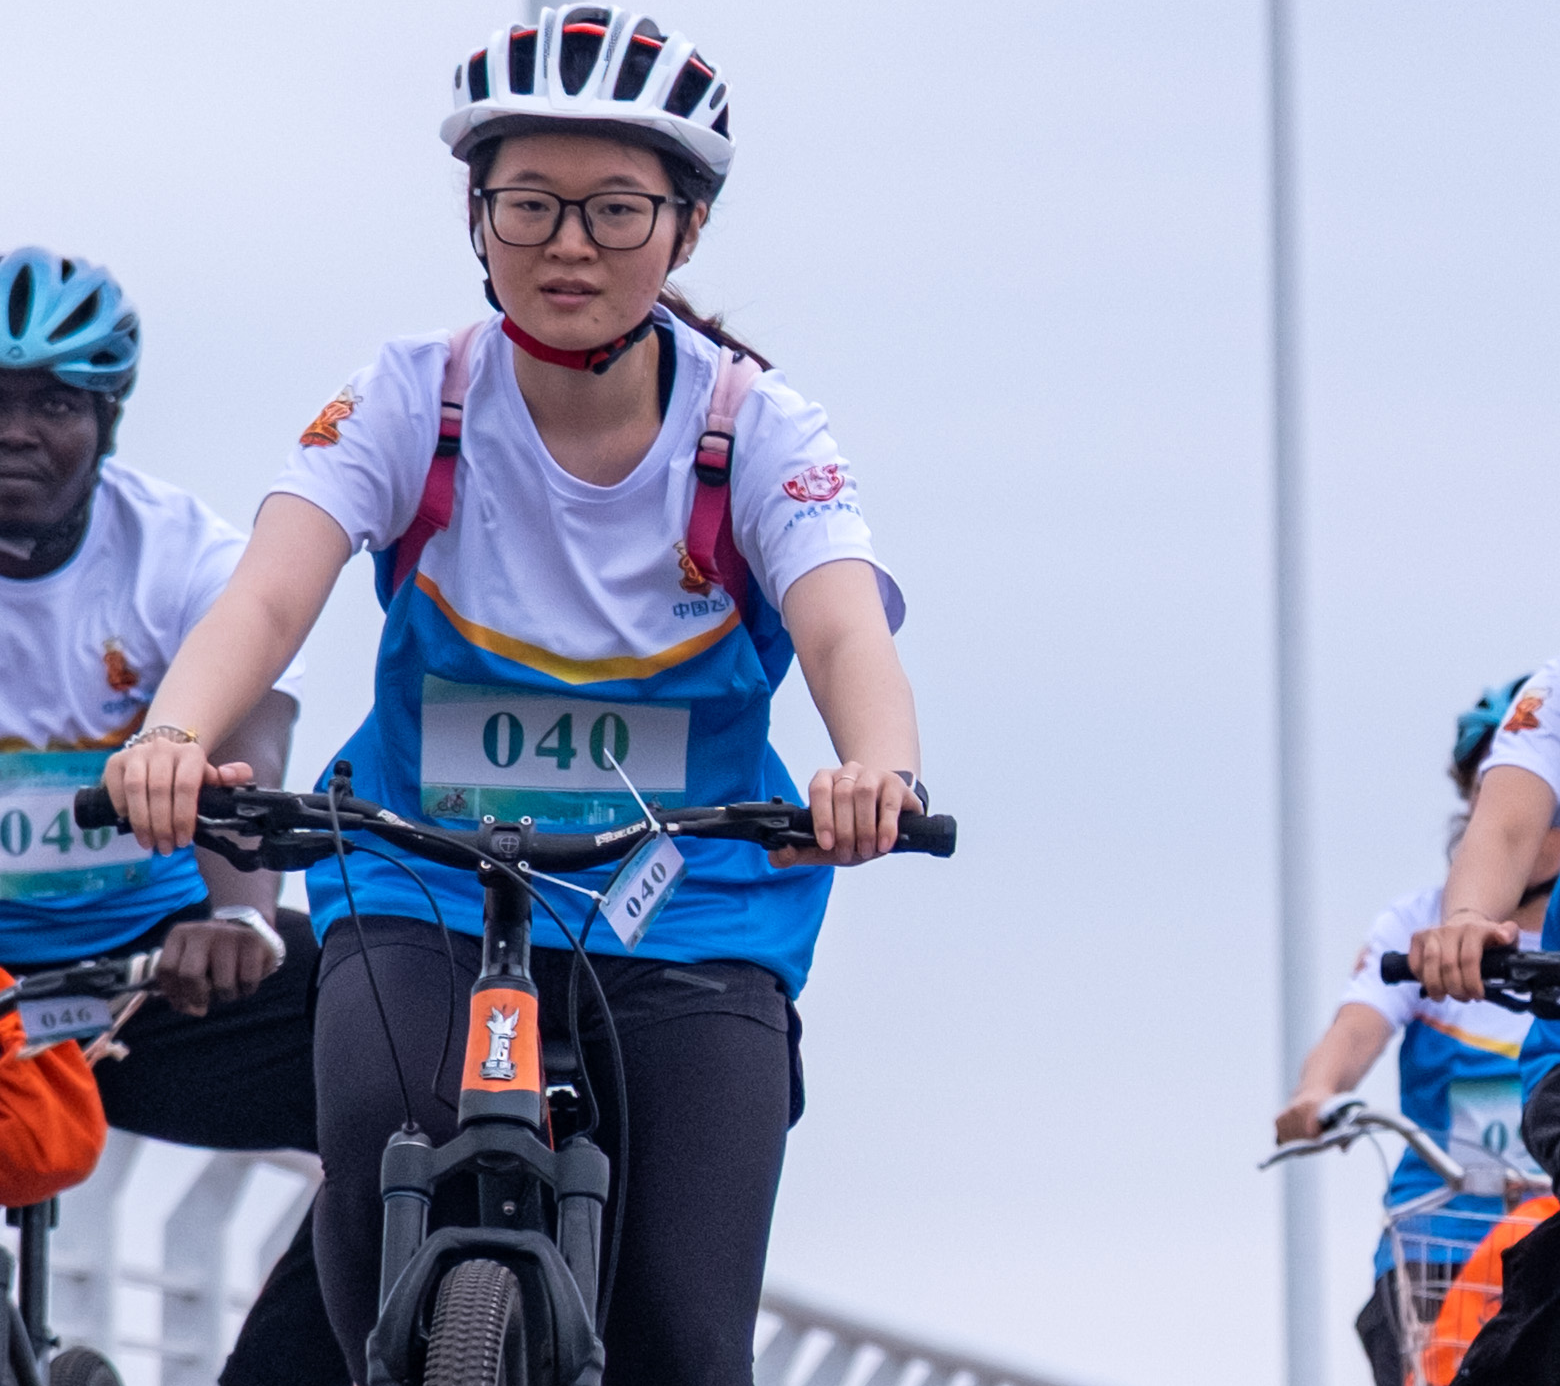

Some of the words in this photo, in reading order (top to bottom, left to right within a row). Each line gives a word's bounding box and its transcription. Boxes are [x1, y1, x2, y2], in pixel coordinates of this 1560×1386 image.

[672, 595, 731, 619] 中国飞
[483, 712, 630, 771] 040
[625, 861, 667, 919] 040
[41, 1008, 92, 1030] 046
